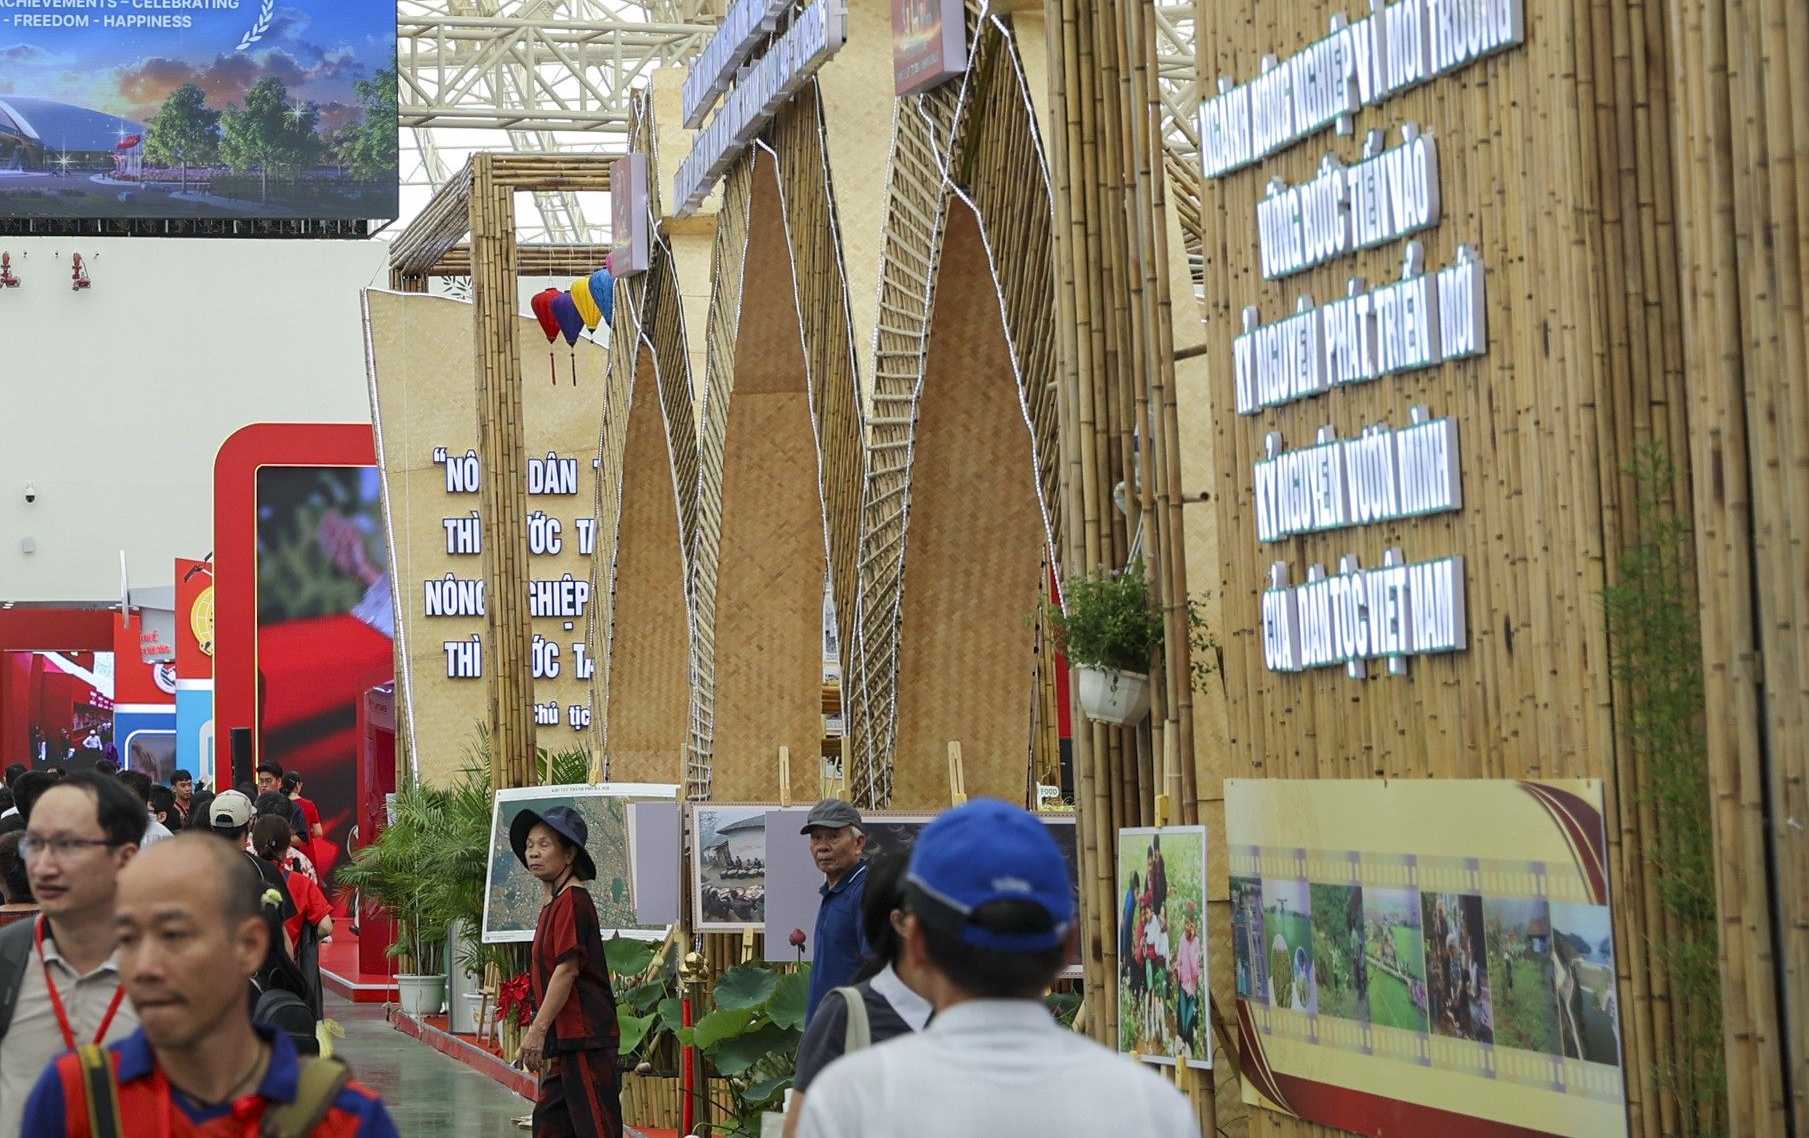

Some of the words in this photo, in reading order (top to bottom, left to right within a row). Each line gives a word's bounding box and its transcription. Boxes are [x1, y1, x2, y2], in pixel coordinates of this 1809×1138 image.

[13, 14, 89, 27] FREEDOM
[103, 14, 192, 28] HAPPINESS
[1199, 77, 1250, 179] NGÀNH
[1252, 56, 1292, 160] NÔNG
[1292, 13, 1354, 136] NGHIỆP
[1302, 154, 1345, 266] BƯỚC
[1348, 130, 1390, 249] TIẾN
[1388, 124, 1430, 236] VÀO
[1234, 308, 1252, 414] KỶ
[1255, 296, 1319, 407] NGUYÊN
[1374, 242, 1430, 374] TRIỂN
[1438, 244, 1474, 358] MỚI
[528, 451, 577, 494] DÂN
[1255, 433, 1278, 542] KỶ
[1277, 426, 1343, 535] NGUYÊN
[1397, 405, 1451, 516] MÌNH
[443, 510, 481, 555] THÌ
[444, 634, 481, 678] THÌ
[1263, 564, 1293, 671] CỦA
[1297, 565, 1333, 666] DÂN
[1330, 557, 1367, 678] TỘC
[1366, 549, 1406, 675] VIỆT
[1410, 558, 1455, 651] NAM
[568, 704, 591, 731] tịc
